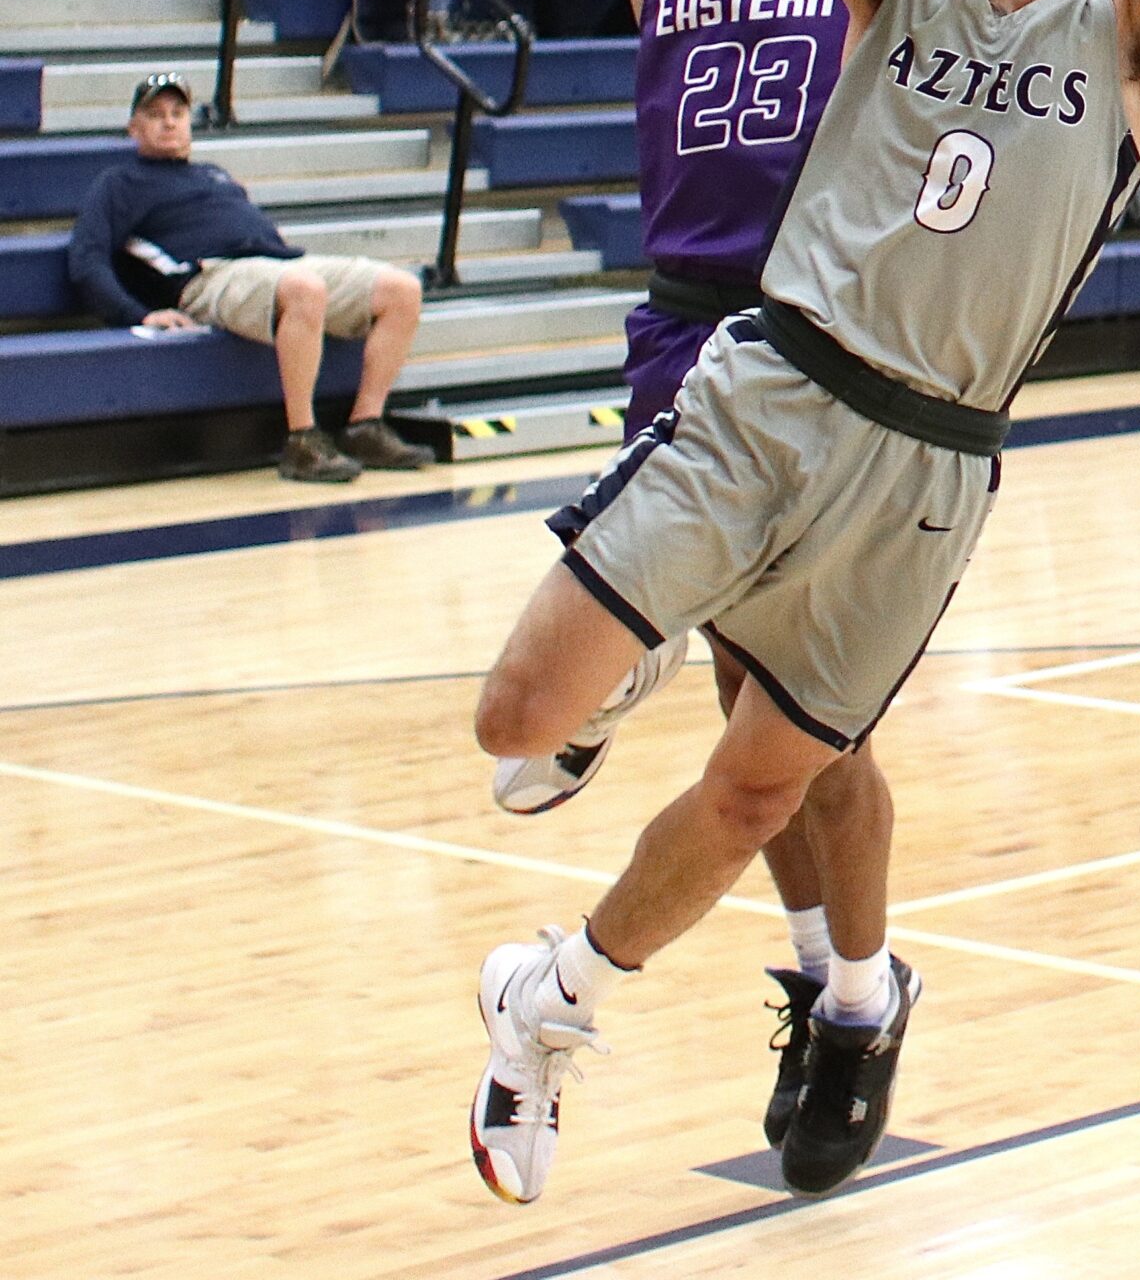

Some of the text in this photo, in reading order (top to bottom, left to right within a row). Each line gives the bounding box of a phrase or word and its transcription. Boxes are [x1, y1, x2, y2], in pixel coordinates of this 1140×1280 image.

[677, 34, 817, 156] 23
[887, 35, 1088, 125] AZTECS
[914, 129, 995, 234] 0
